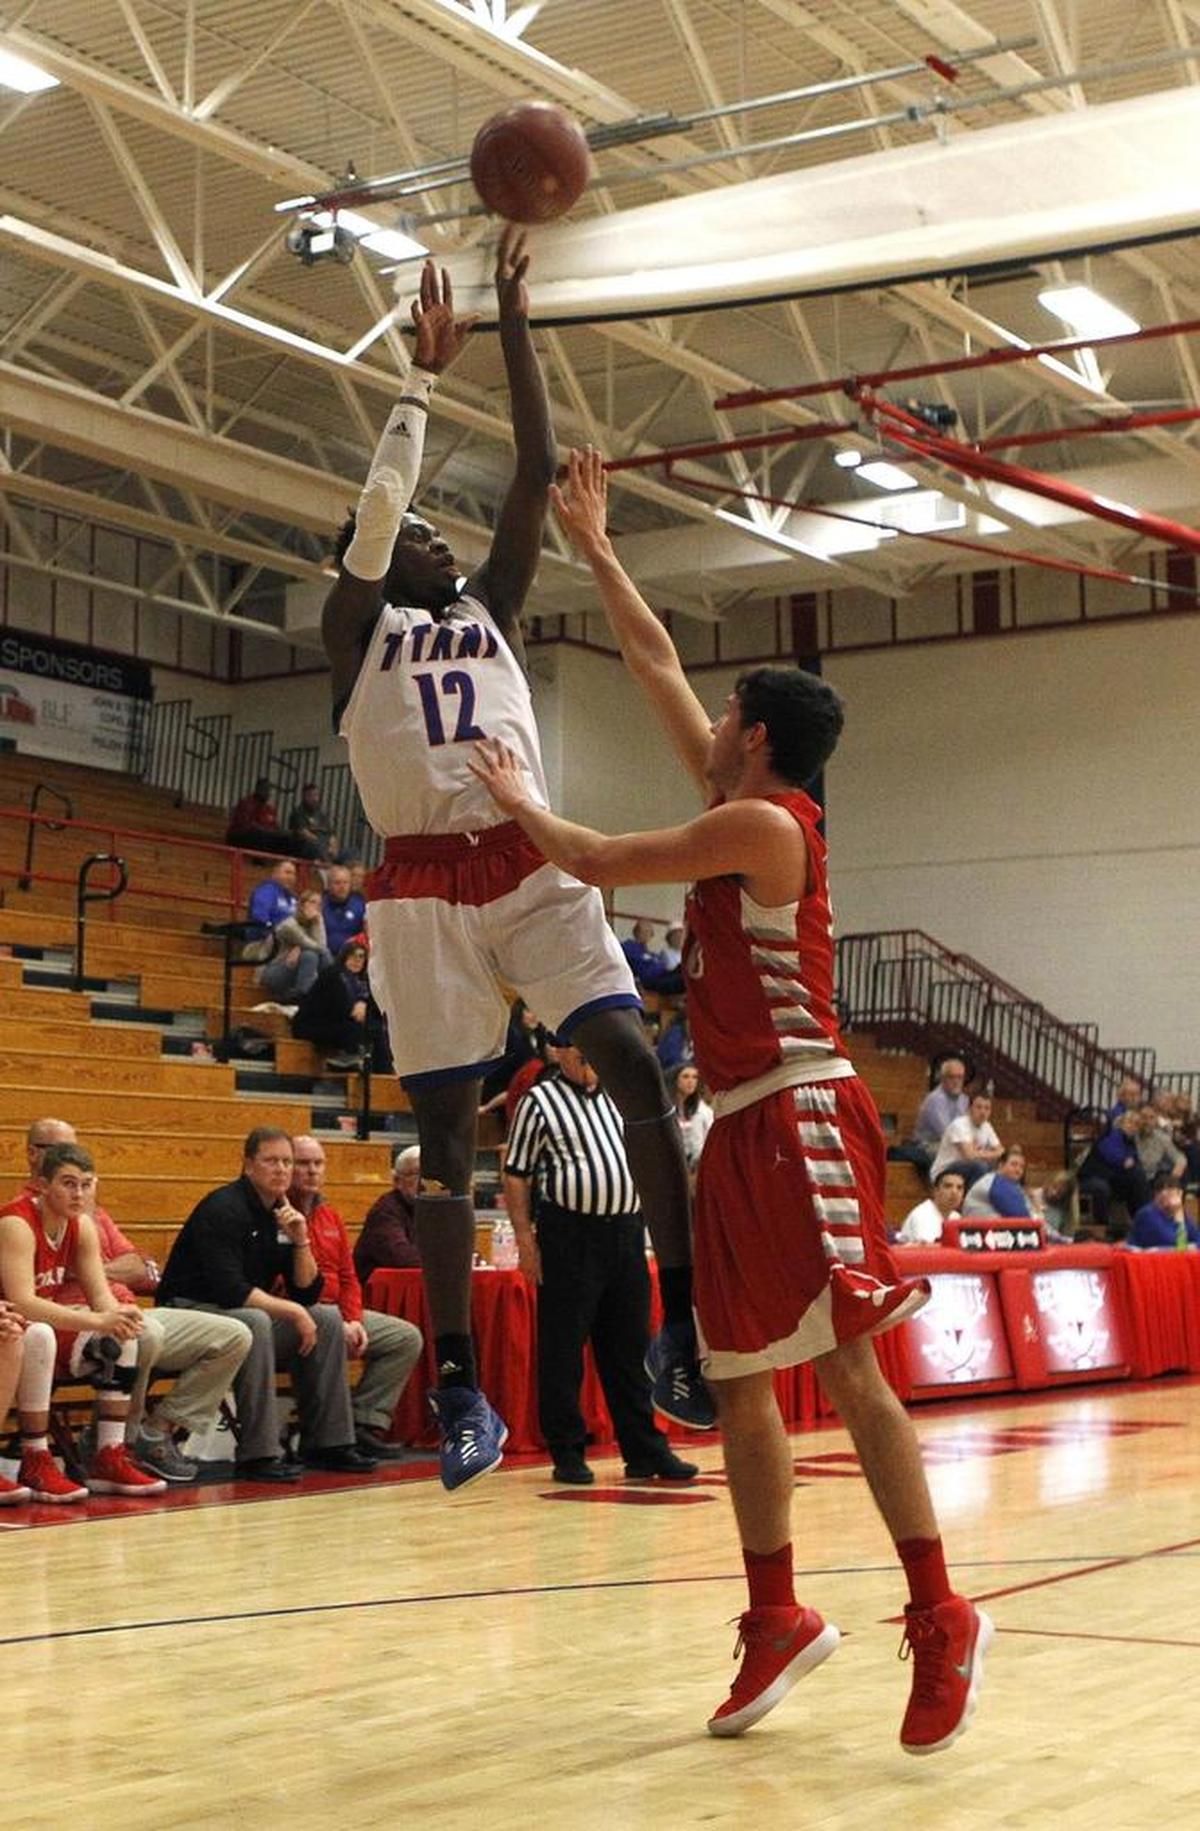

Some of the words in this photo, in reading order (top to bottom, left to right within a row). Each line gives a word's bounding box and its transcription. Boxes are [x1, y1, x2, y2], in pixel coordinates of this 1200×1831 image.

[1, 638, 124, 690] SPONSORS
[380, 623, 499, 671] TTAN
[412, 670, 487, 747] 12
